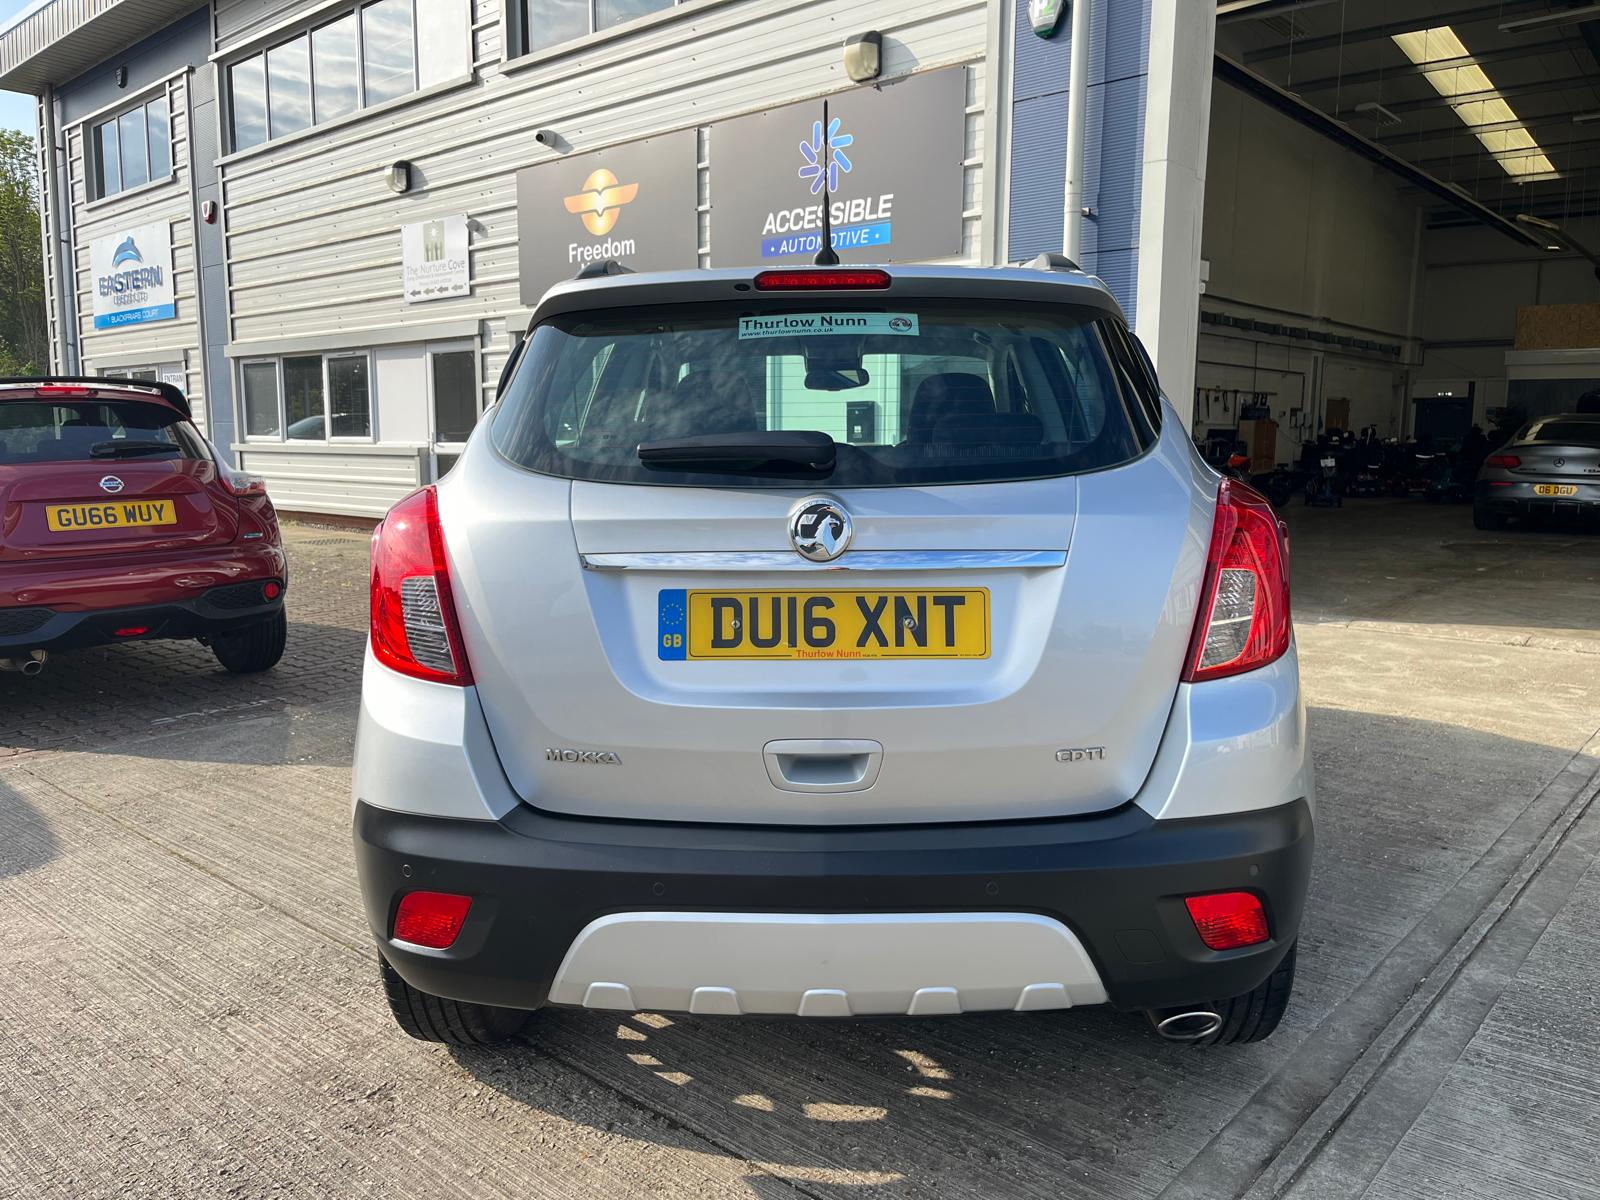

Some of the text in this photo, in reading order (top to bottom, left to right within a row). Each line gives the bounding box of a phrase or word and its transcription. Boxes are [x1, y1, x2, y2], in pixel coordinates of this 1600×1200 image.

[568, 237, 635, 263] Freedom
[420, 262, 447, 273] Nurture
[448, 259, 465, 270] Cove
[98, 265, 163, 296] EASTERN
[742, 315, 867, 331] Thurlow Nunn
[741, 327, 834, 337] www.thurlownunn.co.uk
[164, 374, 184, 382] ENTRAN
[57, 503, 165, 527] GU66 WUY
[711, 595, 966, 649] DU16 XNT
[662, 633, 682, 648] GB
[796, 649, 835, 658] Thurlow
[837, 649, 862, 658] Nunn
[545, 748, 622, 765] MOKKA
